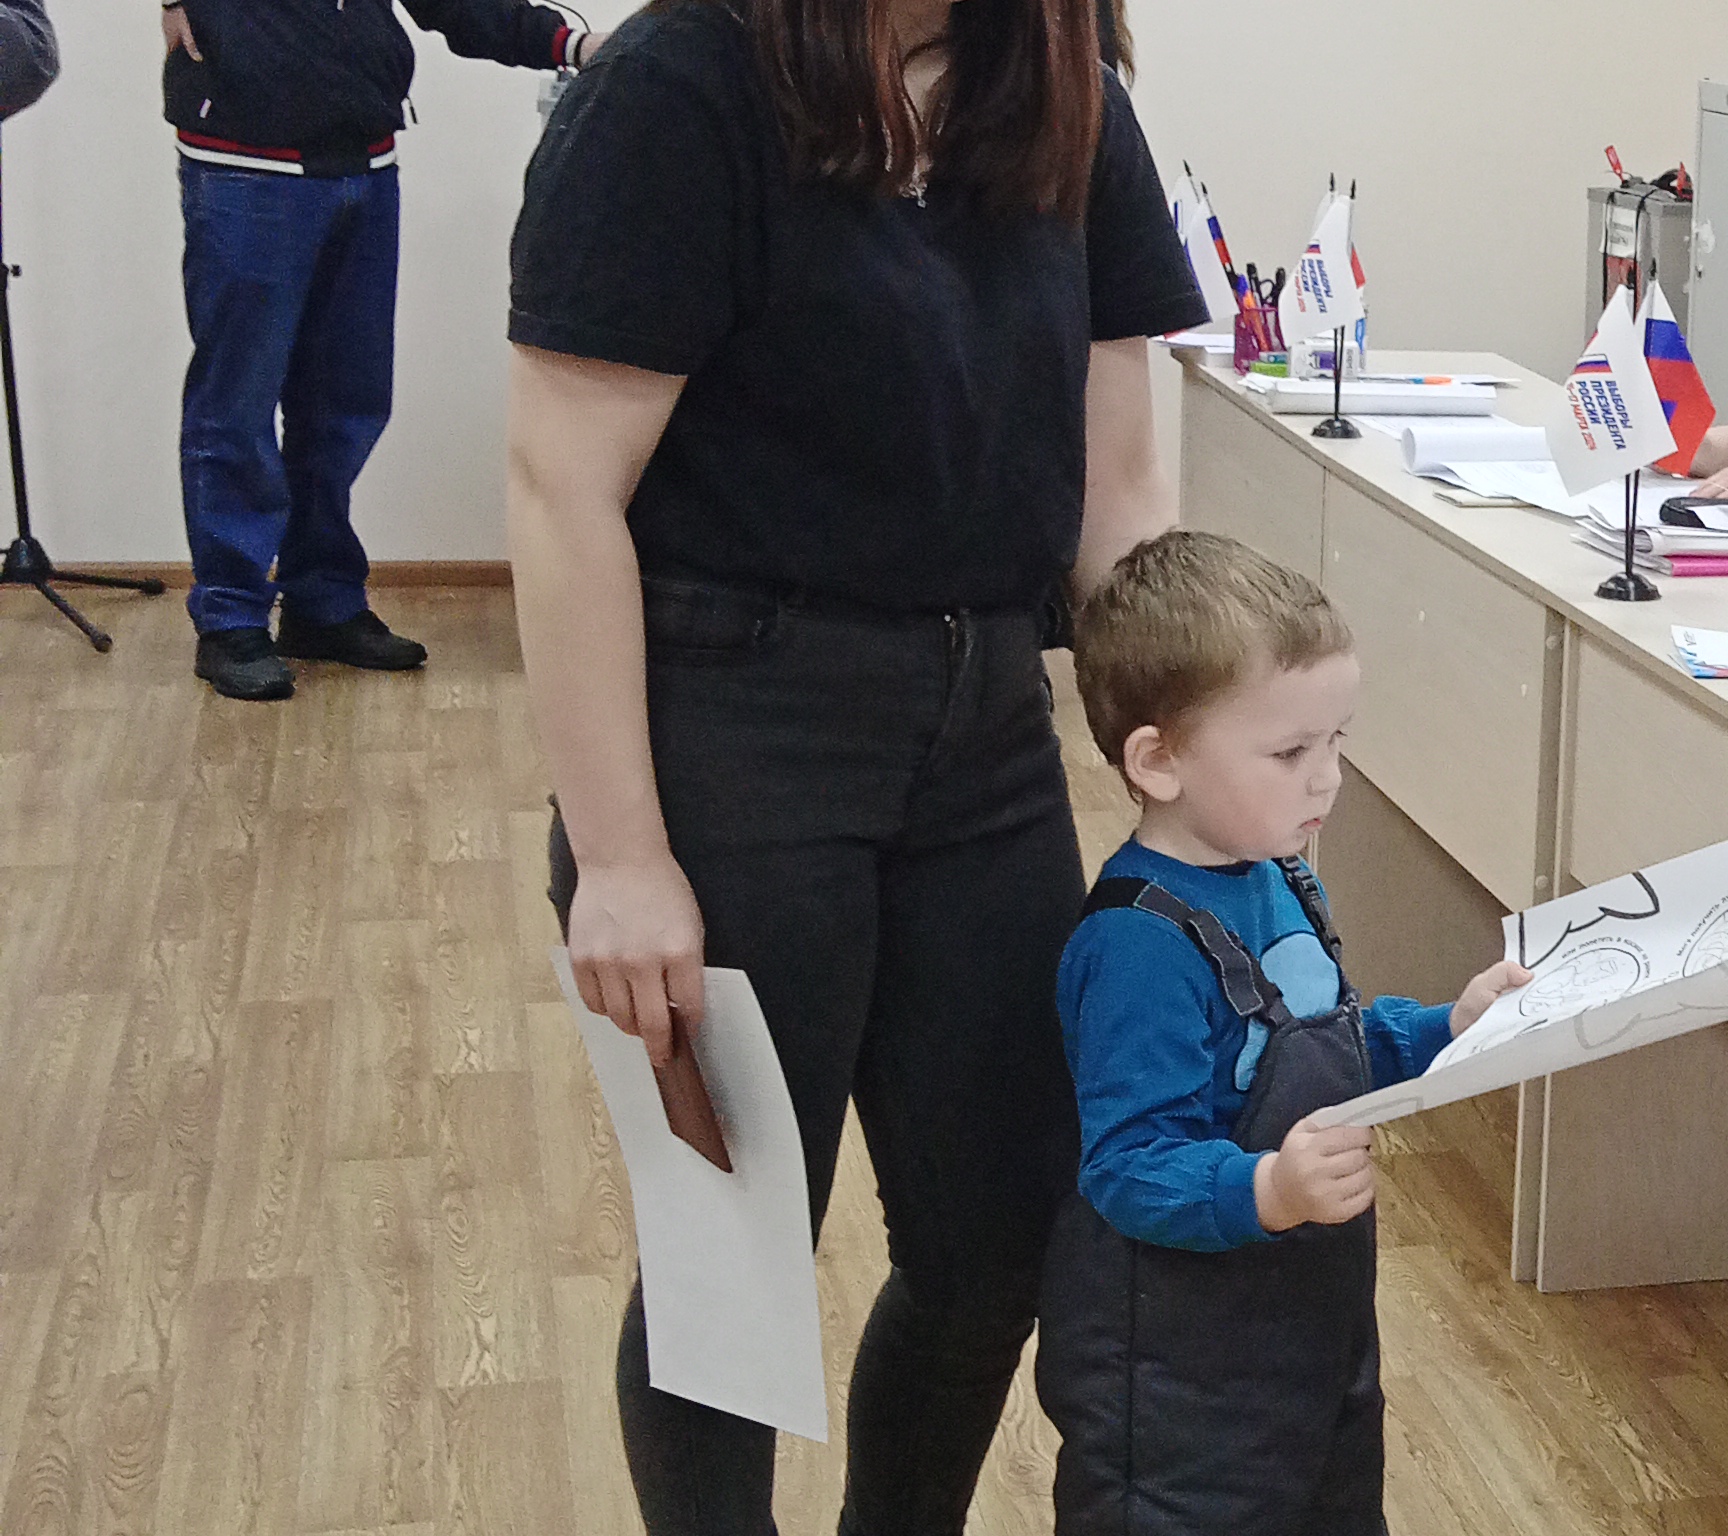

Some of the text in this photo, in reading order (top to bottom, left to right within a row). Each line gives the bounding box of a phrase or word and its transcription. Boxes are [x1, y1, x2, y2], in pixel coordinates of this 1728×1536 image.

[1576, 380, 1602, 425] РОССИИ
[1590, 380, 1626, 450] ПРЕЗИДЕНТА
[1605, 380, 1633, 429] ВЫБОРЫ
